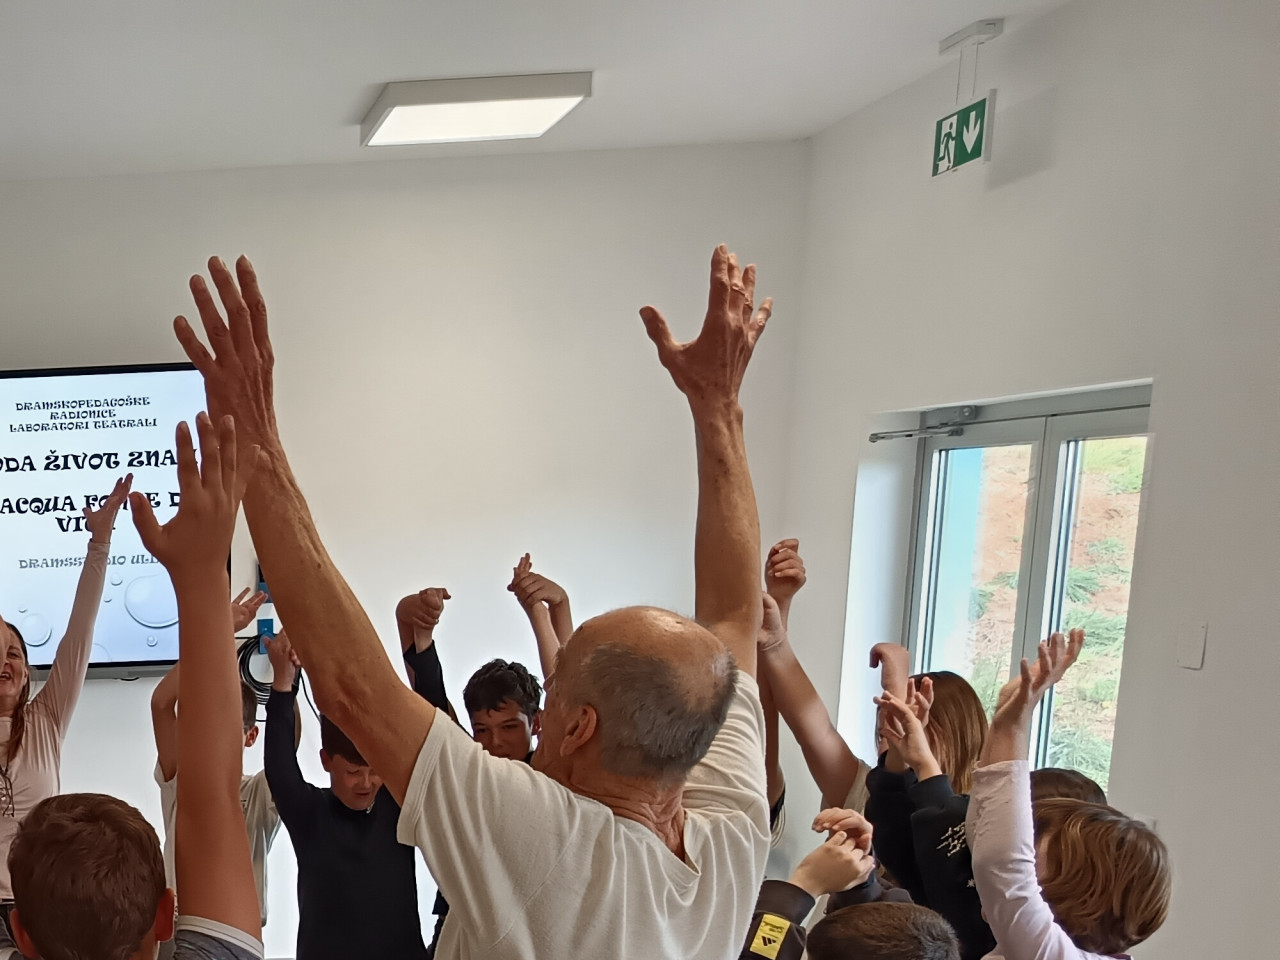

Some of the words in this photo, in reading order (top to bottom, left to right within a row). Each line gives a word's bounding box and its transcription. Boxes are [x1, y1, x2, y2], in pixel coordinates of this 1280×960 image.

[50, 409, 116, 420] RADIONICE
[9, 421, 90, 433] LABORATORI
[93, 418, 158, 430] TEATRALI
[44, 450, 120, 471] ŽIVOT
